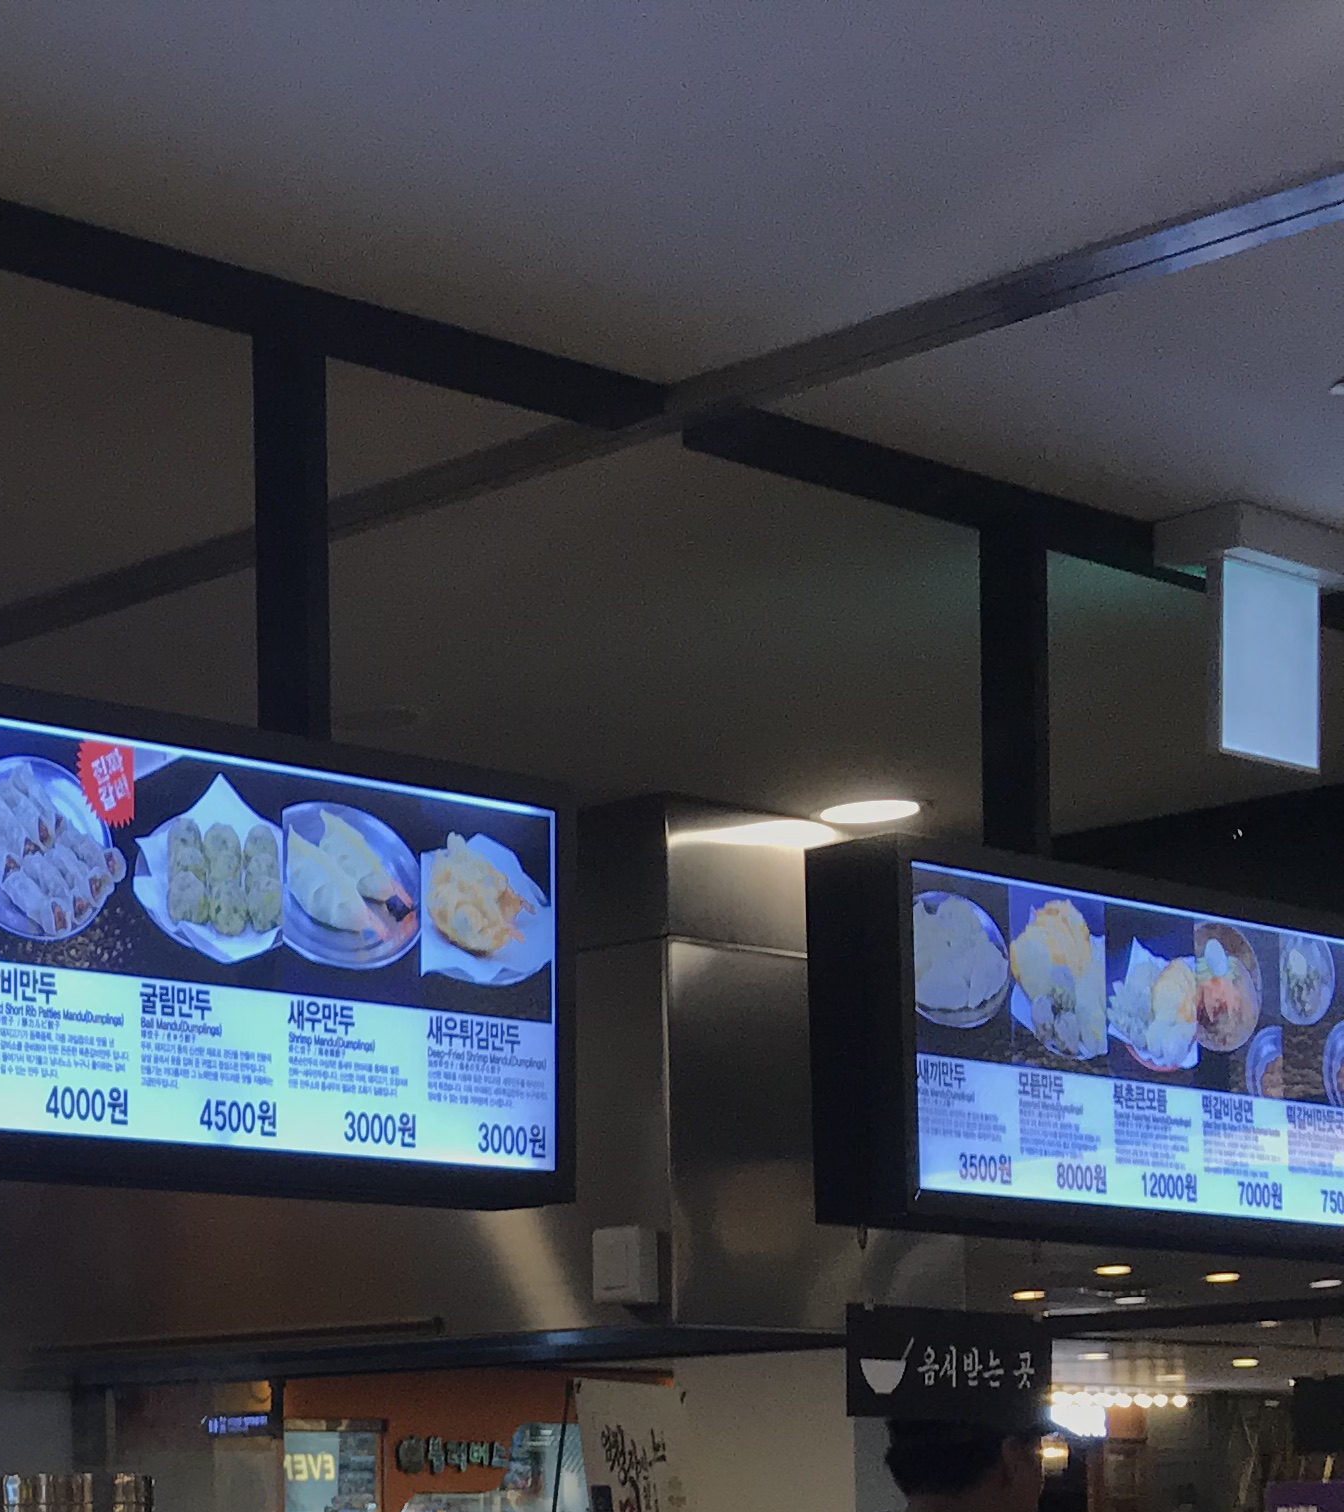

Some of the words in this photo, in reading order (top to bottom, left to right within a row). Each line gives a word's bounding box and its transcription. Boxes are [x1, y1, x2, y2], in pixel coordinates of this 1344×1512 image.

[140, 983, 212, 1021] 굴림만두
[287, 1000, 355, 1036] 새우만두
[427, 1016, 521, 1054] 새우튀김만두
[46, 1085, 128, 1126] 4000원
[200, 1099, 277, 1137] 4500원
[1202, 1094, 1254, 1124] 떡갈비냉면
[344, 1111, 416, 1148] 3000원
[478, 1122, 546, 1158] 3000원
[959, 1152, 1011, 1185] 3500원
[1057, 1163, 1107, 1194] 8000원
[1141, 1172, 1197, 1203] 12000원
[1238, 1181, 1283, 1211] 7000원
[917, 1345, 1005, 1388] 음식받는
[1013, 1350, 1035, 1390] 곳
